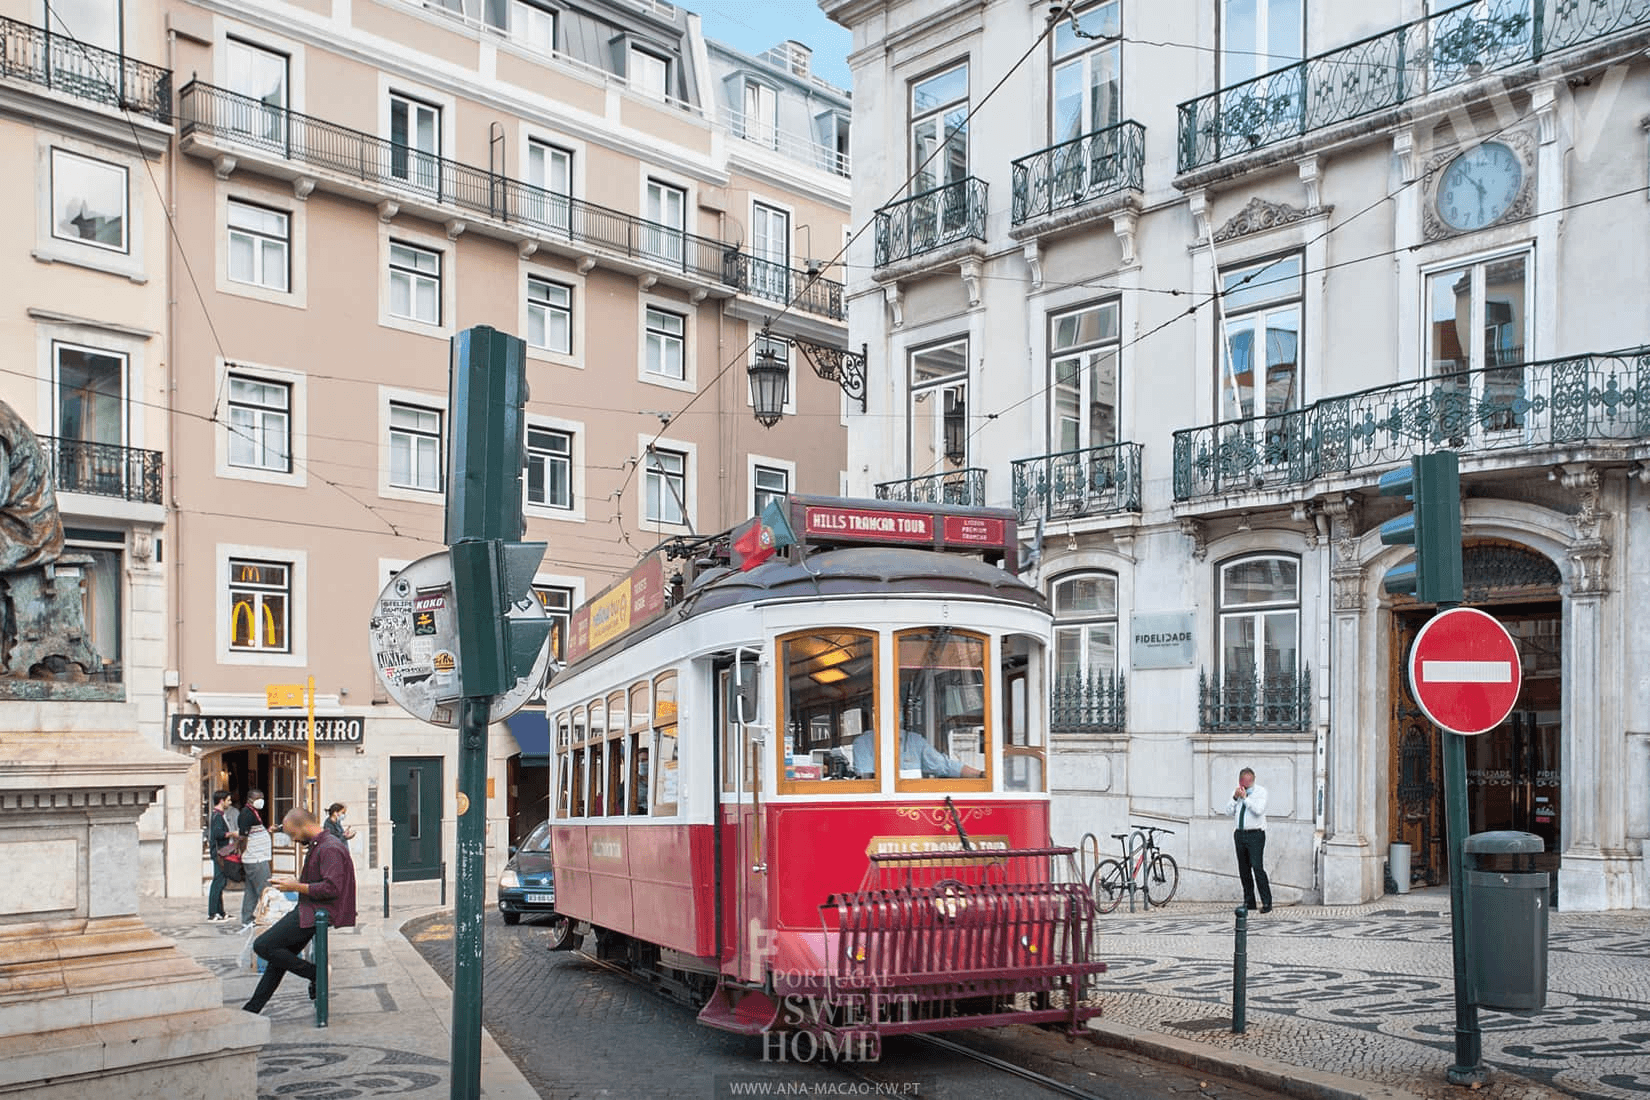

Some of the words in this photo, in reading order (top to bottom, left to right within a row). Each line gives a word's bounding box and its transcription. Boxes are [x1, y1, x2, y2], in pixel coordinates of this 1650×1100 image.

[1446, 191, 1454, 205] 9
[812, 513, 847, 529] HILLS
[848, 515, 897, 532] TRAMCAR
[897, 518, 927, 534] TOUR
[416, 598, 444, 609] KOKO
[1135, 632, 1192, 644] FIDELIDADE
[177, 718, 360, 741] CABELLEIREIRO
